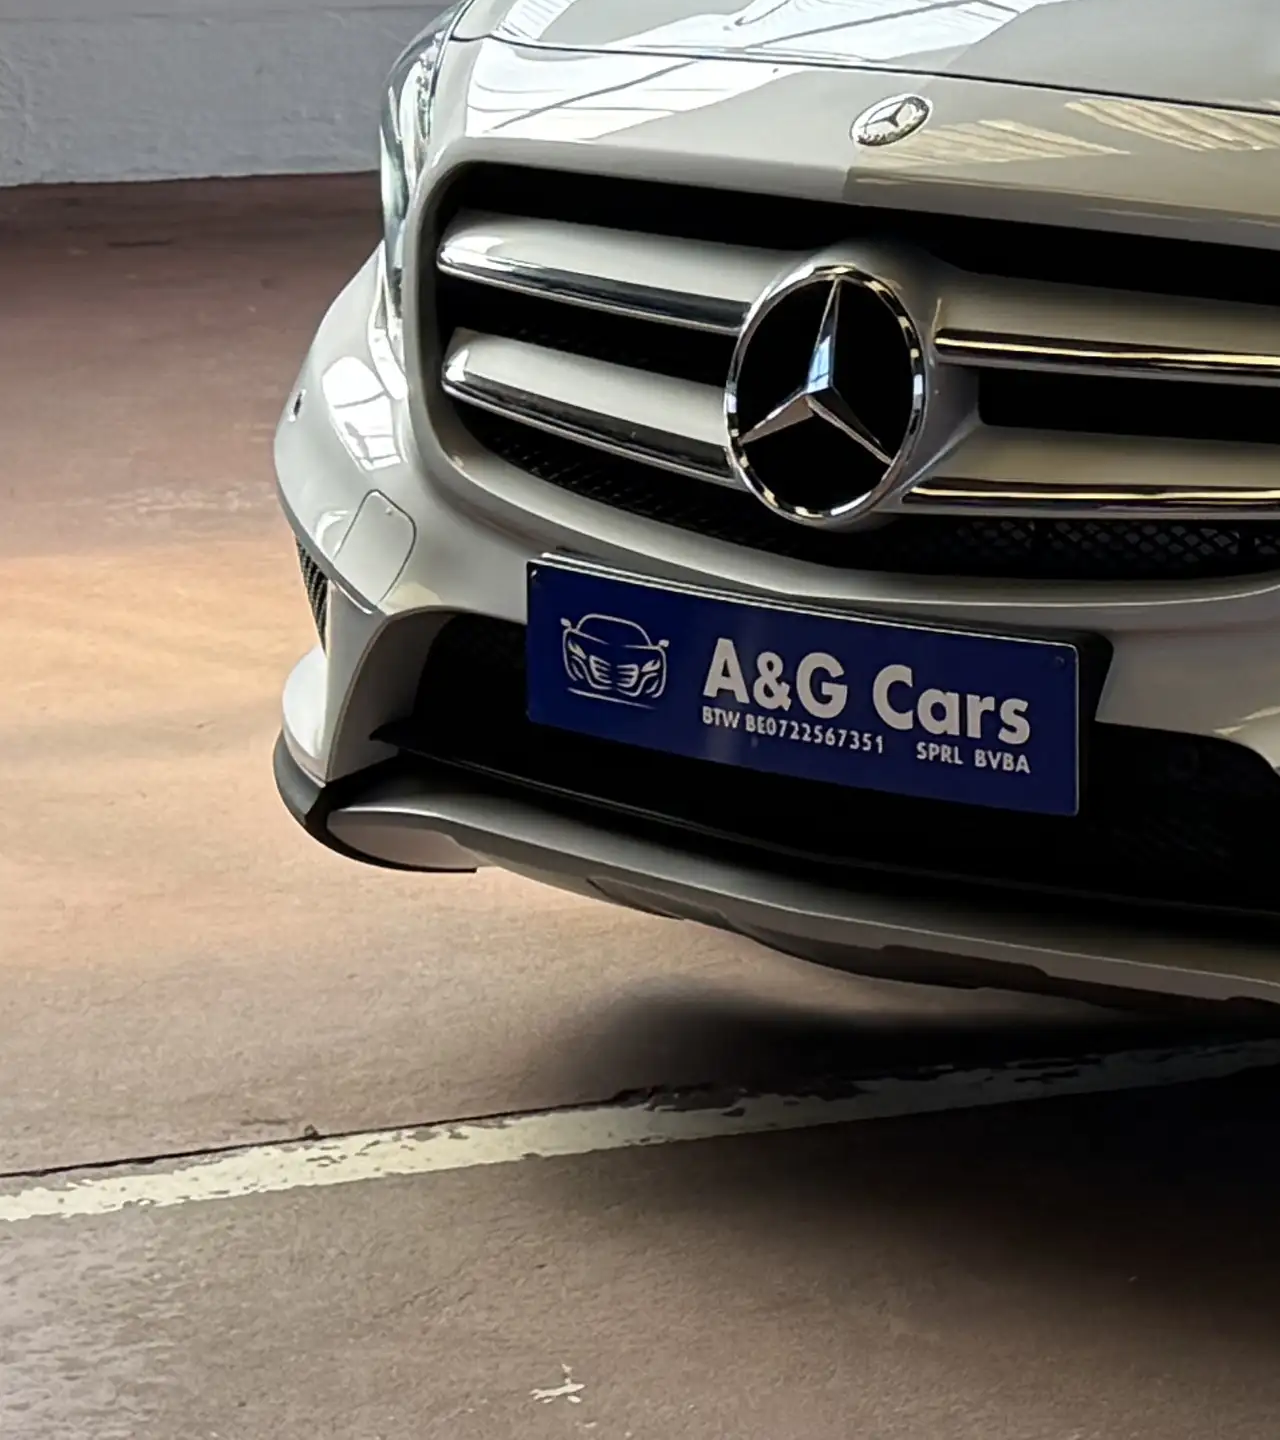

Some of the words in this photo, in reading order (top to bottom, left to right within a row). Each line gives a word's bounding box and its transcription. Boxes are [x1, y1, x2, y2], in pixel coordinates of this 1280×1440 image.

[703, 637, 848, 719] A&G
[872, 664, 1031, 745] Cars
[702, 706, 740, 729] BTW
[745, 713, 884, 754] BE0722567351
[916, 742, 964, 766] SPRL
[974, 750, 1031, 774] BVBA
